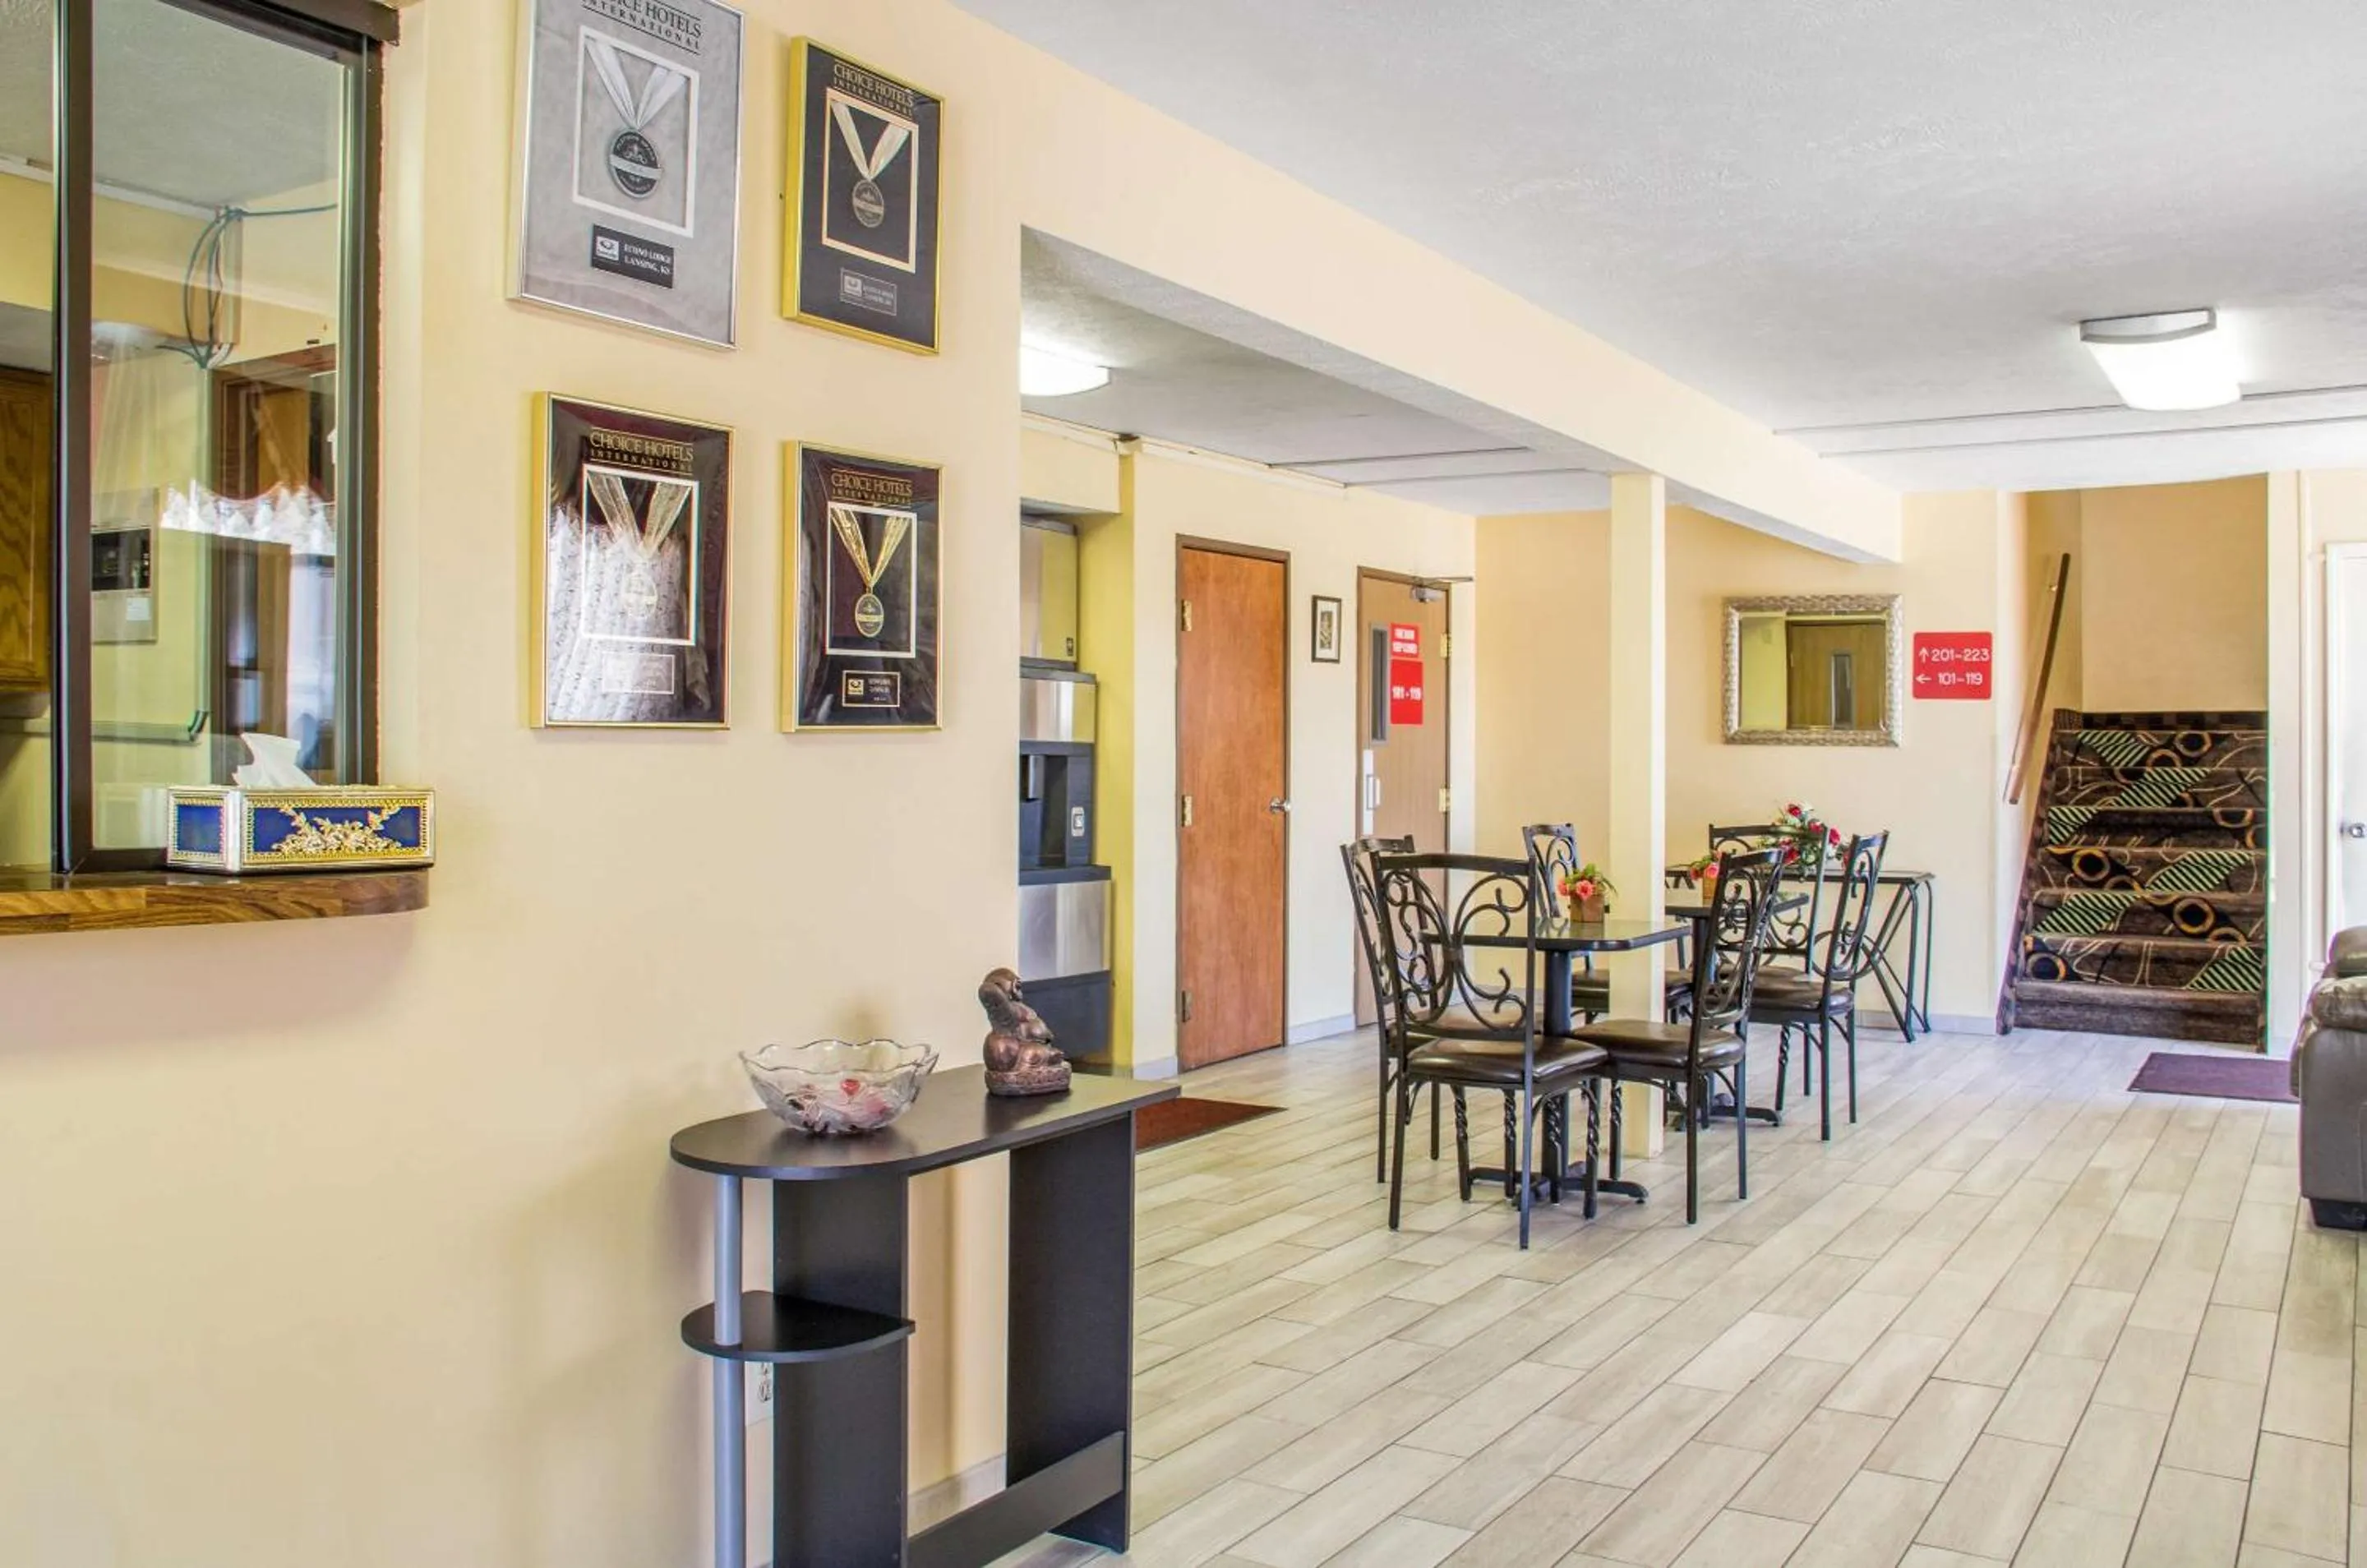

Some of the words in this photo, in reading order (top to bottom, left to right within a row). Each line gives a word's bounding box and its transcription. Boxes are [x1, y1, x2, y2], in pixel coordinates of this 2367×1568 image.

[580, 0, 700, 50] NTERNATIONAL
[645, 1, 702, 38] HOTELS
[833, 63, 874, 91] CHOICE
[875, 79, 915, 108] HOTELS
[833, 75, 912, 117] INTERNATIONAL
[589, 431, 643, 453] CHOICE
[644, 440, 694, 462] HOTELS
[590, 449, 693, 473] INTERNATIONAL
[831, 473, 872, 491] CHOICE
[874, 478, 912, 497] HOTELS
[1931, 647, 1990, 662] 201-223
[1937, 672, 1983, 686] 101-119
